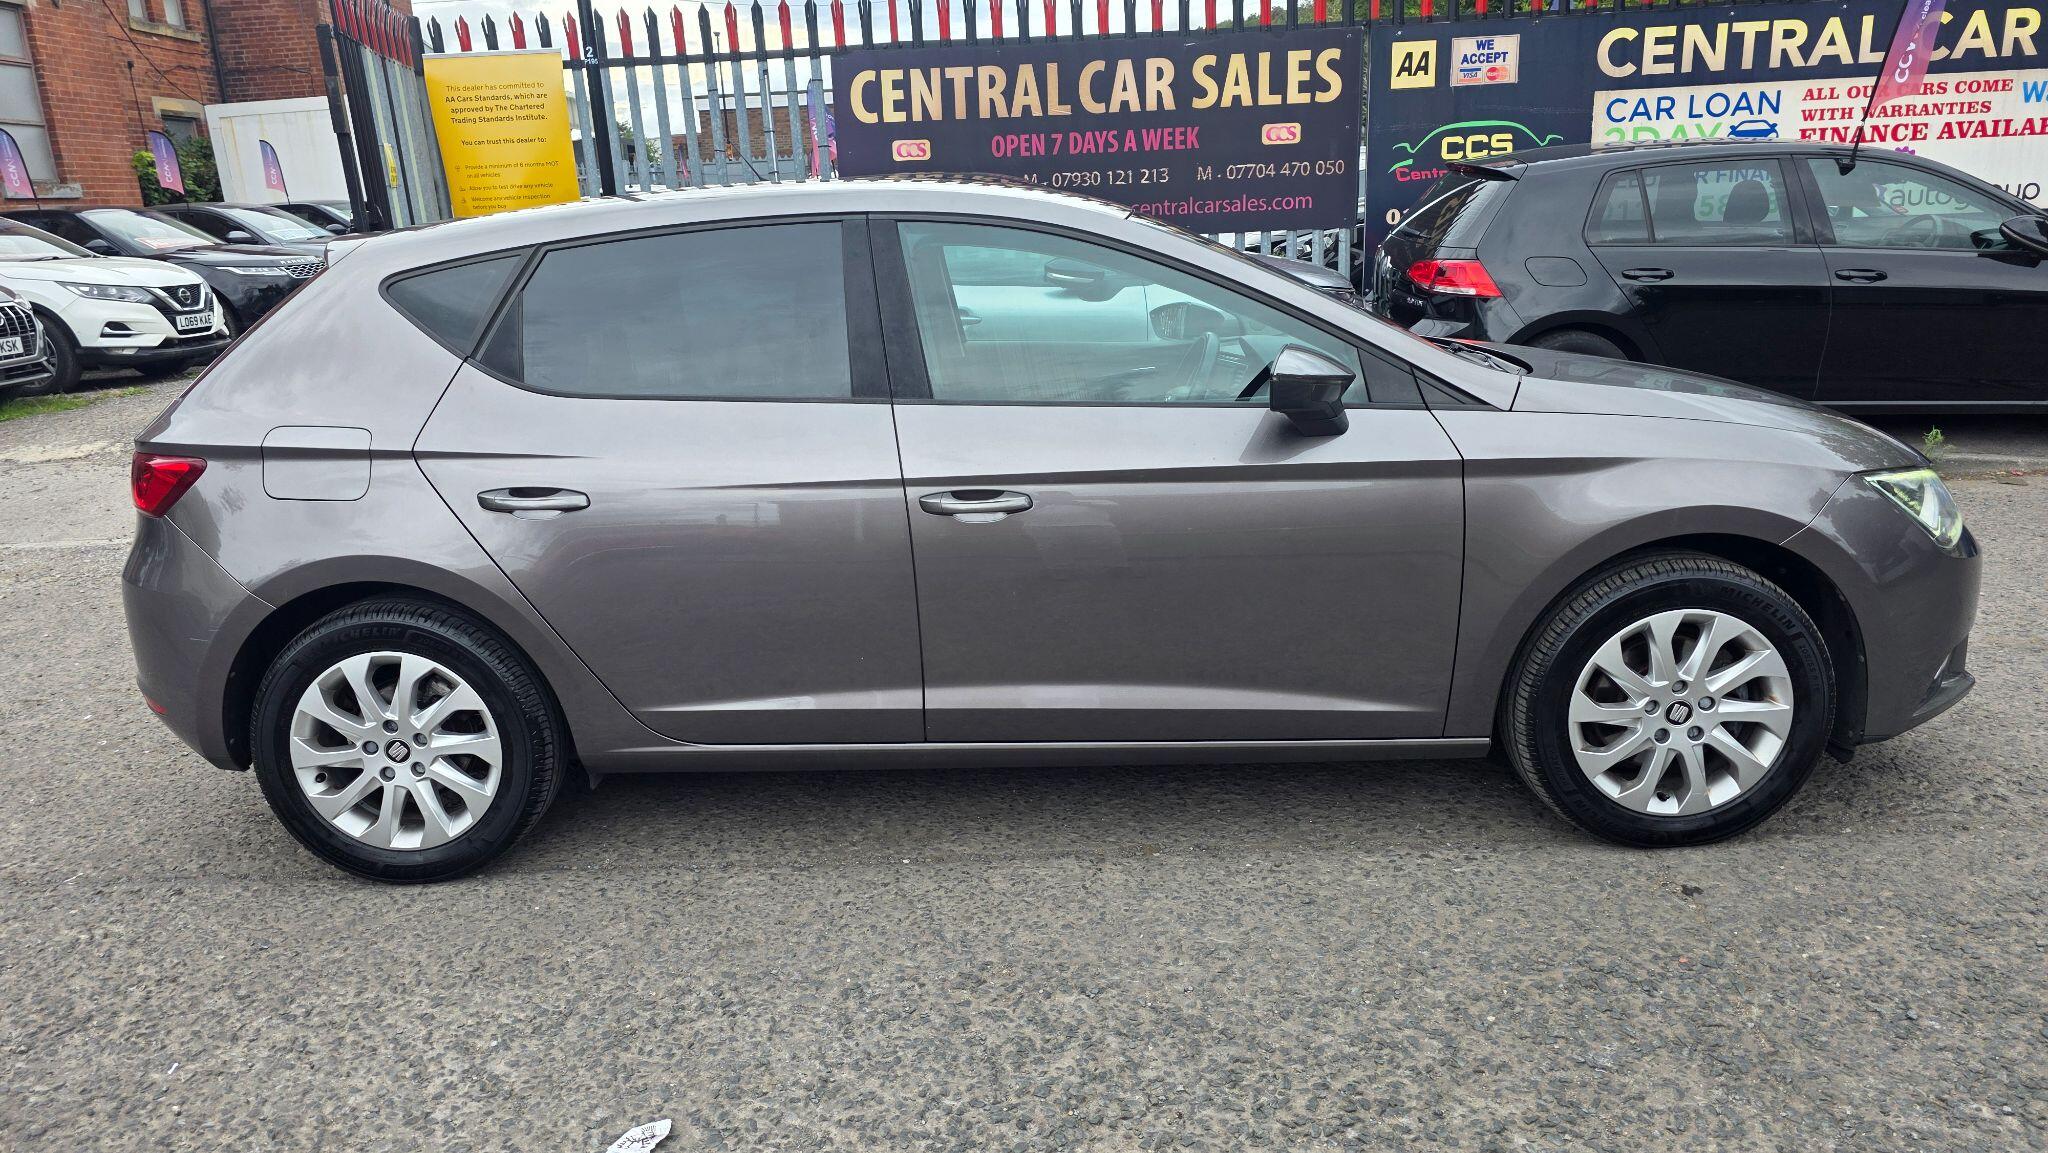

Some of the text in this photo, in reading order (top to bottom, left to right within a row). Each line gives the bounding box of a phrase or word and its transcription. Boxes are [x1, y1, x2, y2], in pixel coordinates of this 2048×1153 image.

[586, 46, 593, 58] 2
[1476, 39, 1495, 51] WE
[1597, 7, 2041, 78] CENTRAL CAR
[1396, 51, 1430, 77] AA
[1461, 51, 1509, 65] ACCEPT
[474, 94, 513, 102] Standards,
[514, 92, 534, 100] which
[499, 82, 535, 90] committed
[849, 47, 1342, 125] CENTRAL CAR SALES
[1801, 85, 1840, 102] ALL
[1955, 79, 2014, 94] COME
[450, 106, 483, 114] approved
[509, 103, 545, 111] Chartered
[1606, 90, 1782, 123] CAR LOAN
[1801, 100, 1992, 122] WITH WARRANTIES
[478, 115, 514, 123] Standards
[515, 113, 548, 121] Institute.
[991, 126, 1200, 158] OPEN 7 DAYS A WEEK
[1799, 122, 1929, 145] FINANCE
[1441, 133, 1513, 160] CCS
[1052, 171, 1100, 188] 07930
[1107, 169, 1133, 185] 121
[1140, 167, 1169, 184] 213
[1196, 166, 1212, 181] M
[1226, 163, 1276, 180] 07704
[1280, 162, 1310, 177] 470
[1316, 159, 1346, 176] 050
[199, 314, 213, 326] KAE
